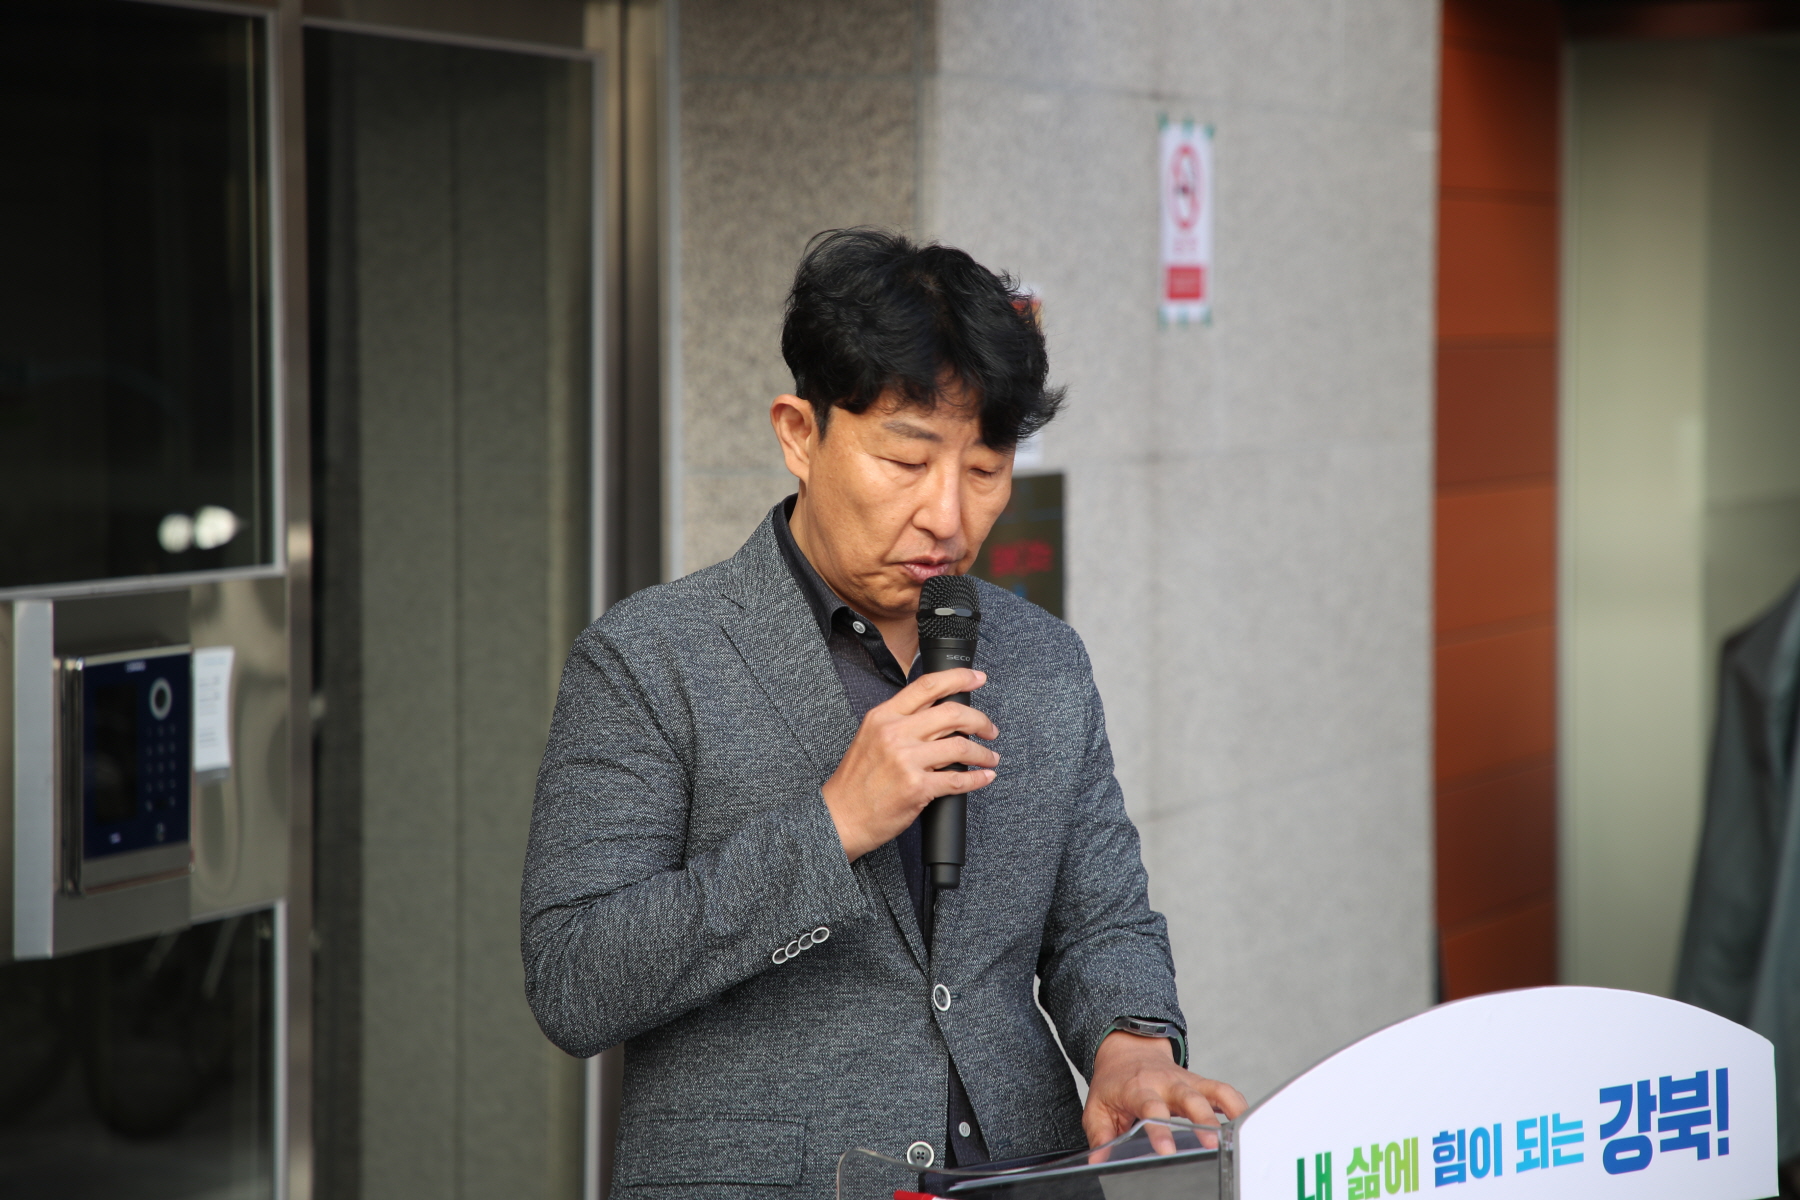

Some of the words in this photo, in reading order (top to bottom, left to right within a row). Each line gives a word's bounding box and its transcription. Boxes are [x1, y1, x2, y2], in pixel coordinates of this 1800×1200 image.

[1297, 1151, 1333, 1200] 내
[1346, 1136, 1419, 1200] 삶에
[1432, 1123, 1504, 1188] 힘이
[1515, 1112, 1585, 1174] 되는
[1599, 1066, 1730, 1175] 강북!
